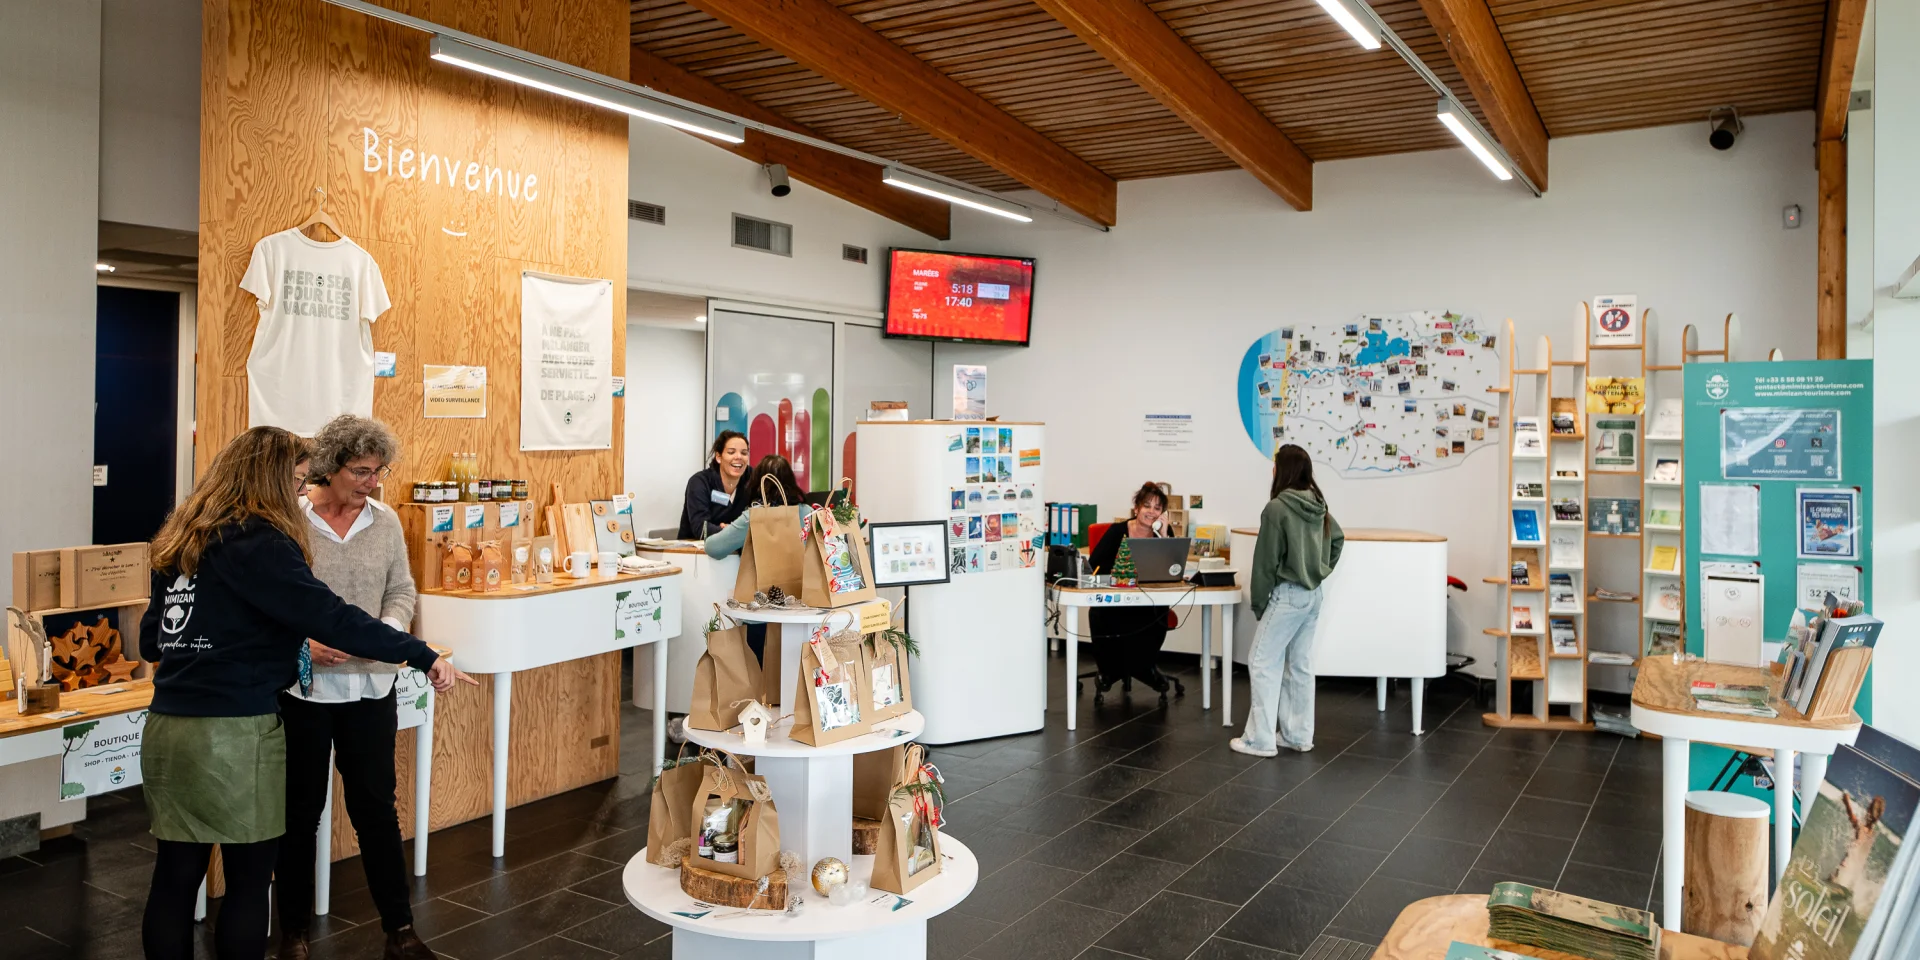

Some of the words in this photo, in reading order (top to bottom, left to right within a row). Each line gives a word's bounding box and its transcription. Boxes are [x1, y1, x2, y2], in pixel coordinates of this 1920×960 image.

[363, 127, 538, 202] Bienvenue
[283, 269, 314, 286] MER
[326, 274, 352, 291] SEA
[283, 285, 323, 302] POUR
[327, 289, 351, 306] LES
[952, 283, 973, 294] 5:18
[945, 296, 973, 307] 17:40
[283, 300, 350, 321] VACANCES
[549, 325, 562, 338] NE
[1754, 382, 1864, 390] contact@mimizan-tourisme.com
[541, 389, 554, 401] DE
[556, 389, 585, 401] PLAGE
[165, 593, 195, 605] MIMIZAN
[94, 732, 140, 749] BOUTIQUE
[84, 759, 101, 768] SHOP
[105, 754, 126, 763] TIENDA
[1784, 880, 1850, 948] soleil
